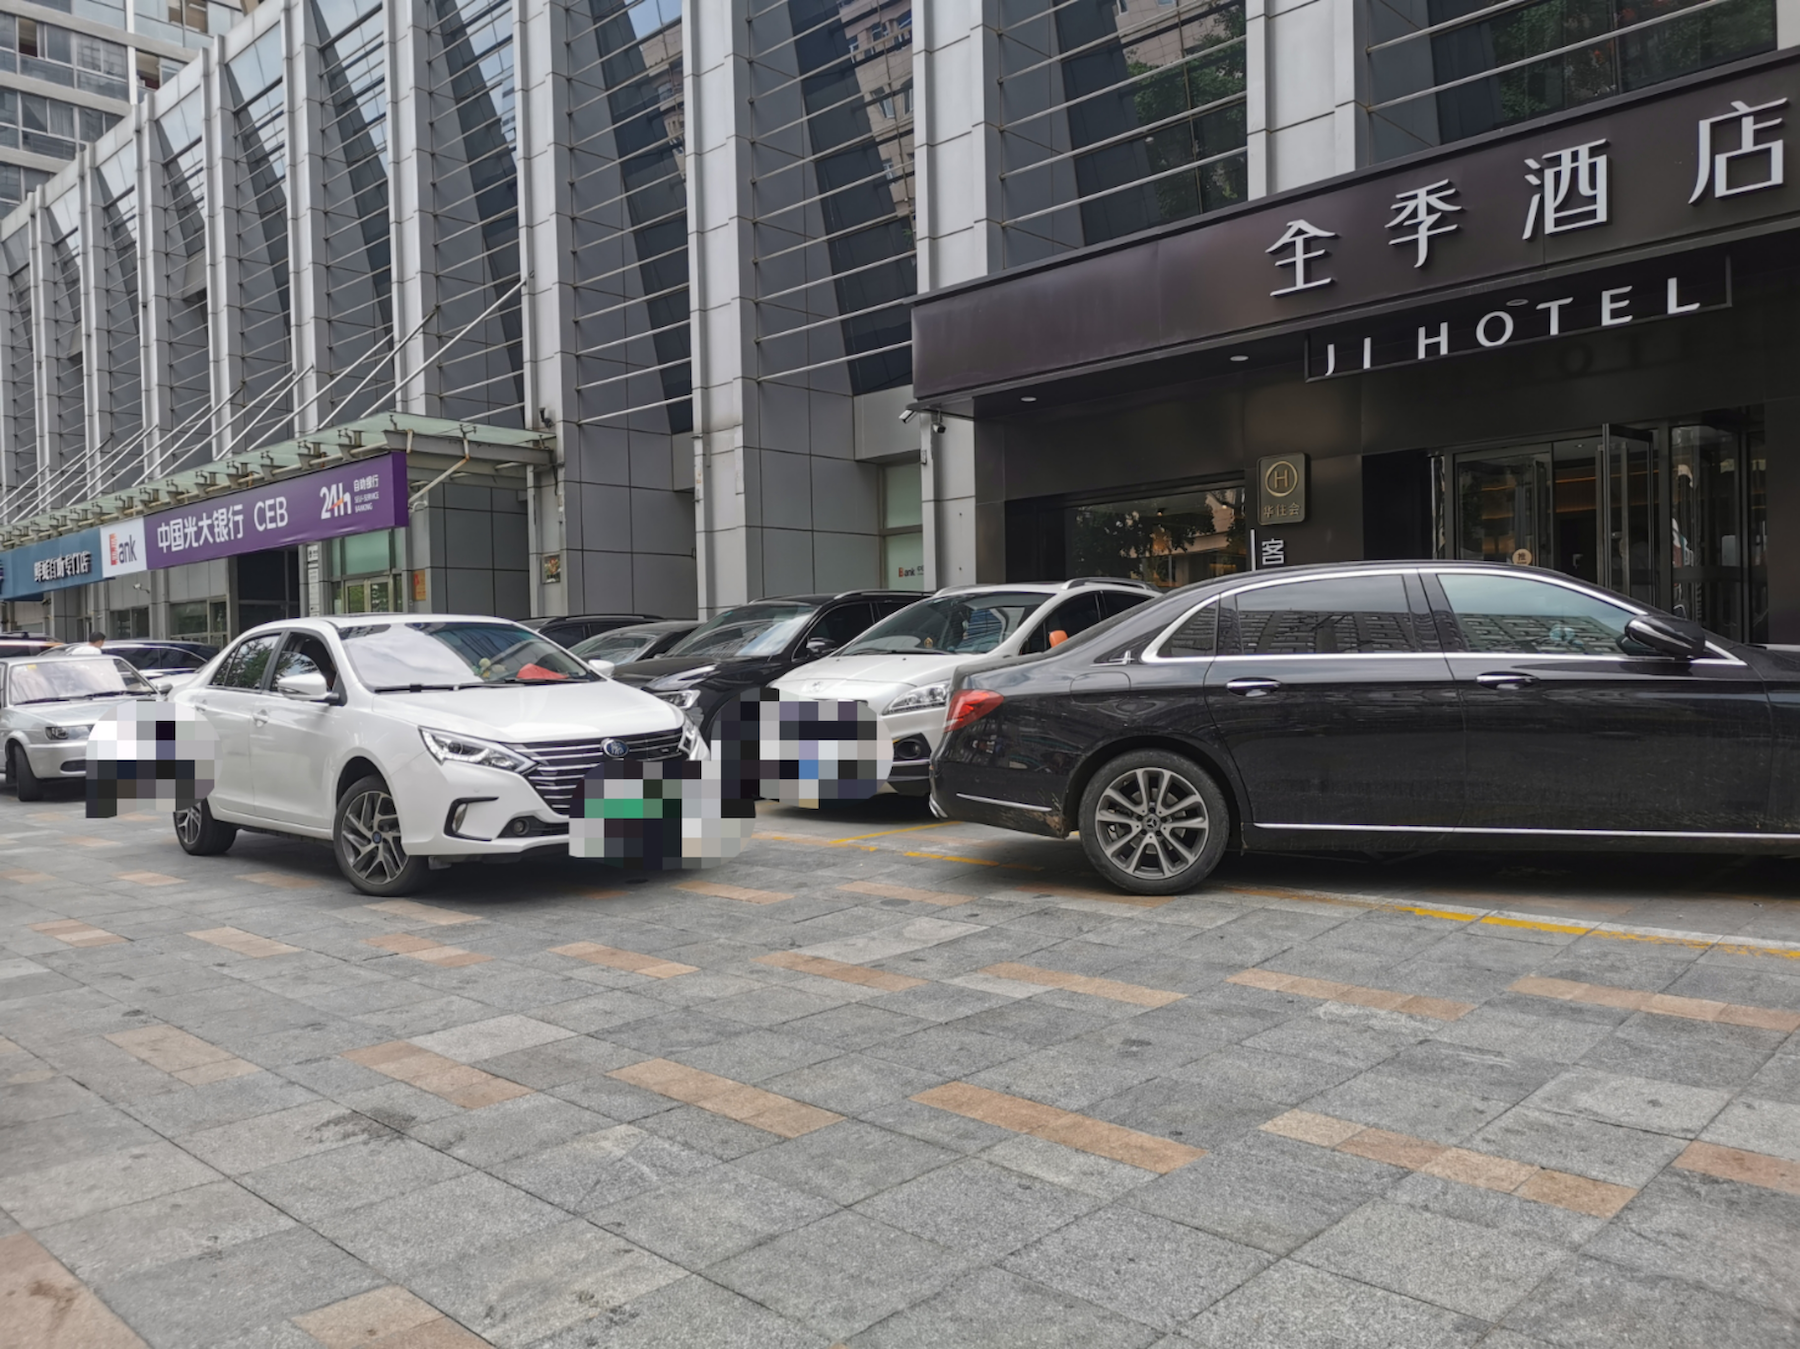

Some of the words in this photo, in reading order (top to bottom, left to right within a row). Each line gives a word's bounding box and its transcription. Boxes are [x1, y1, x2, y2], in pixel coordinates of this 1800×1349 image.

[1265, 98, 1788, 297] 全季酒店
[1325, 337, 1371, 377] JI
[1417, 277, 1700, 359] HOTEL
[320, 482, 351, 519] 24h
[354, 474, 379, 492] 自助银行
[157, 504, 244, 553] 中国光大银行
[254, 496, 288, 532] CEB
[1263, 502, 1300, 518] 华住会
[1262, 538, 1284, 565] 客
